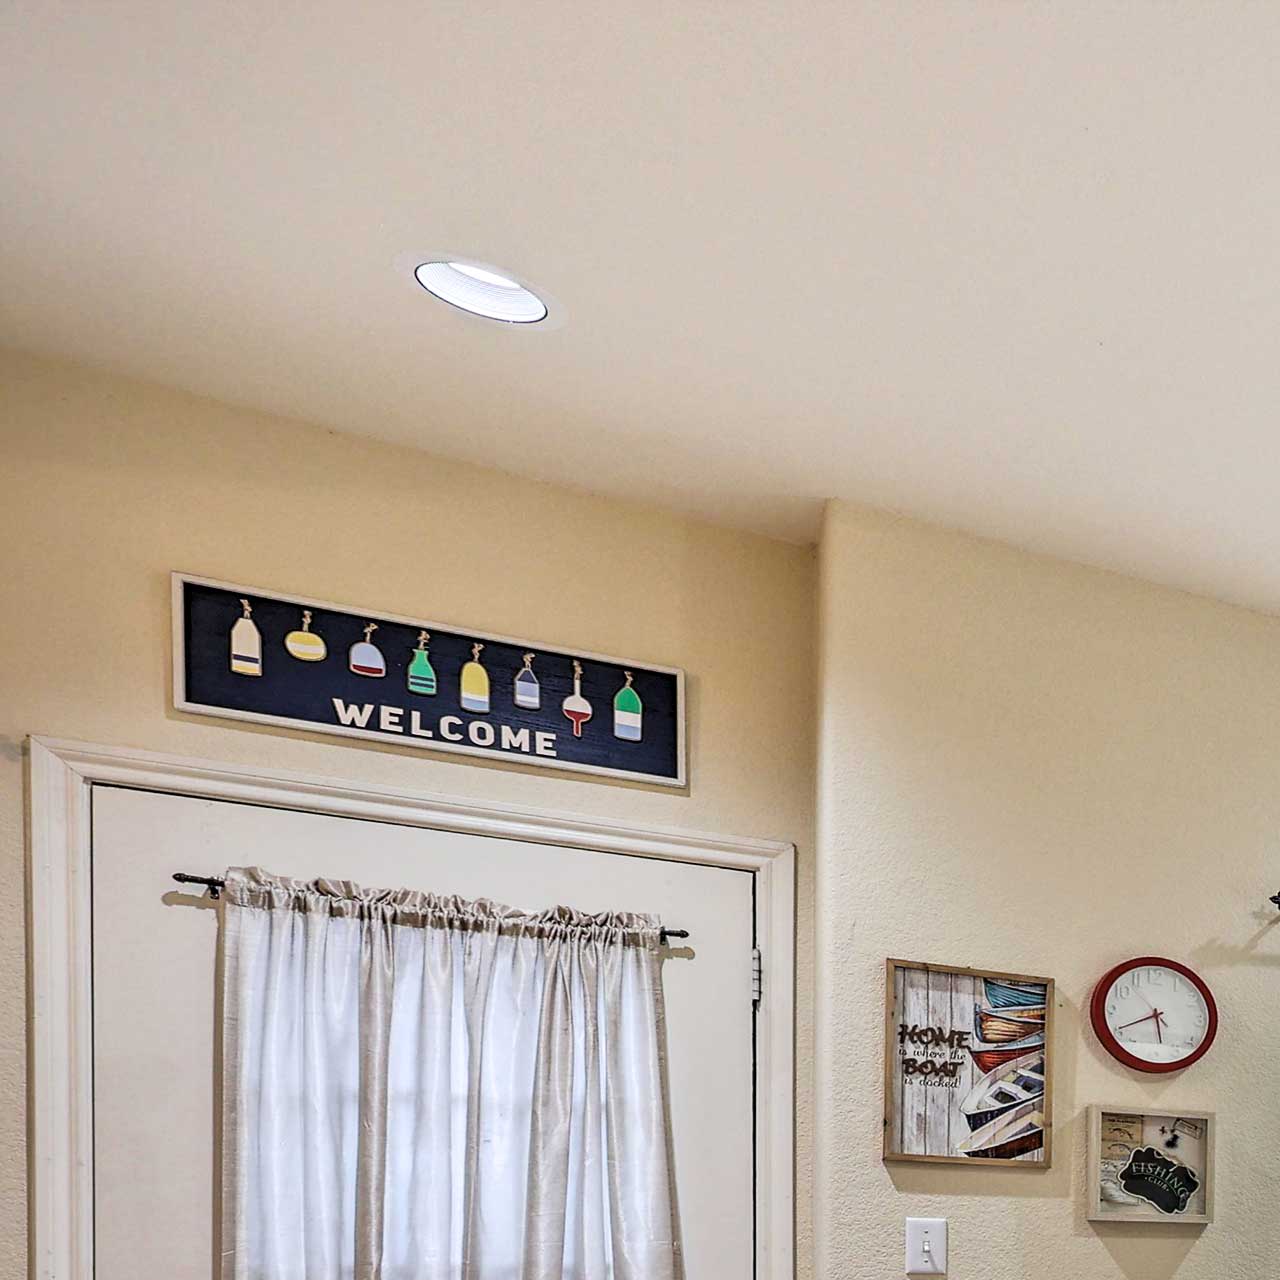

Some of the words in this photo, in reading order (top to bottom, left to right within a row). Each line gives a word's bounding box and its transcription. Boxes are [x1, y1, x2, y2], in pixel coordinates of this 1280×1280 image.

[332, 697, 558, 757] WELCOME
[898, 1024, 972, 1049] HOME
[898, 1045, 908, 1056] is
[913, 1046, 946, 1059] where
[949, 1048, 966, 1061] the
[902, 1057, 965, 1078] BOAT
[904, 1075, 914, 1086] is
[1131, 1161, 1189, 1200] FISHING
